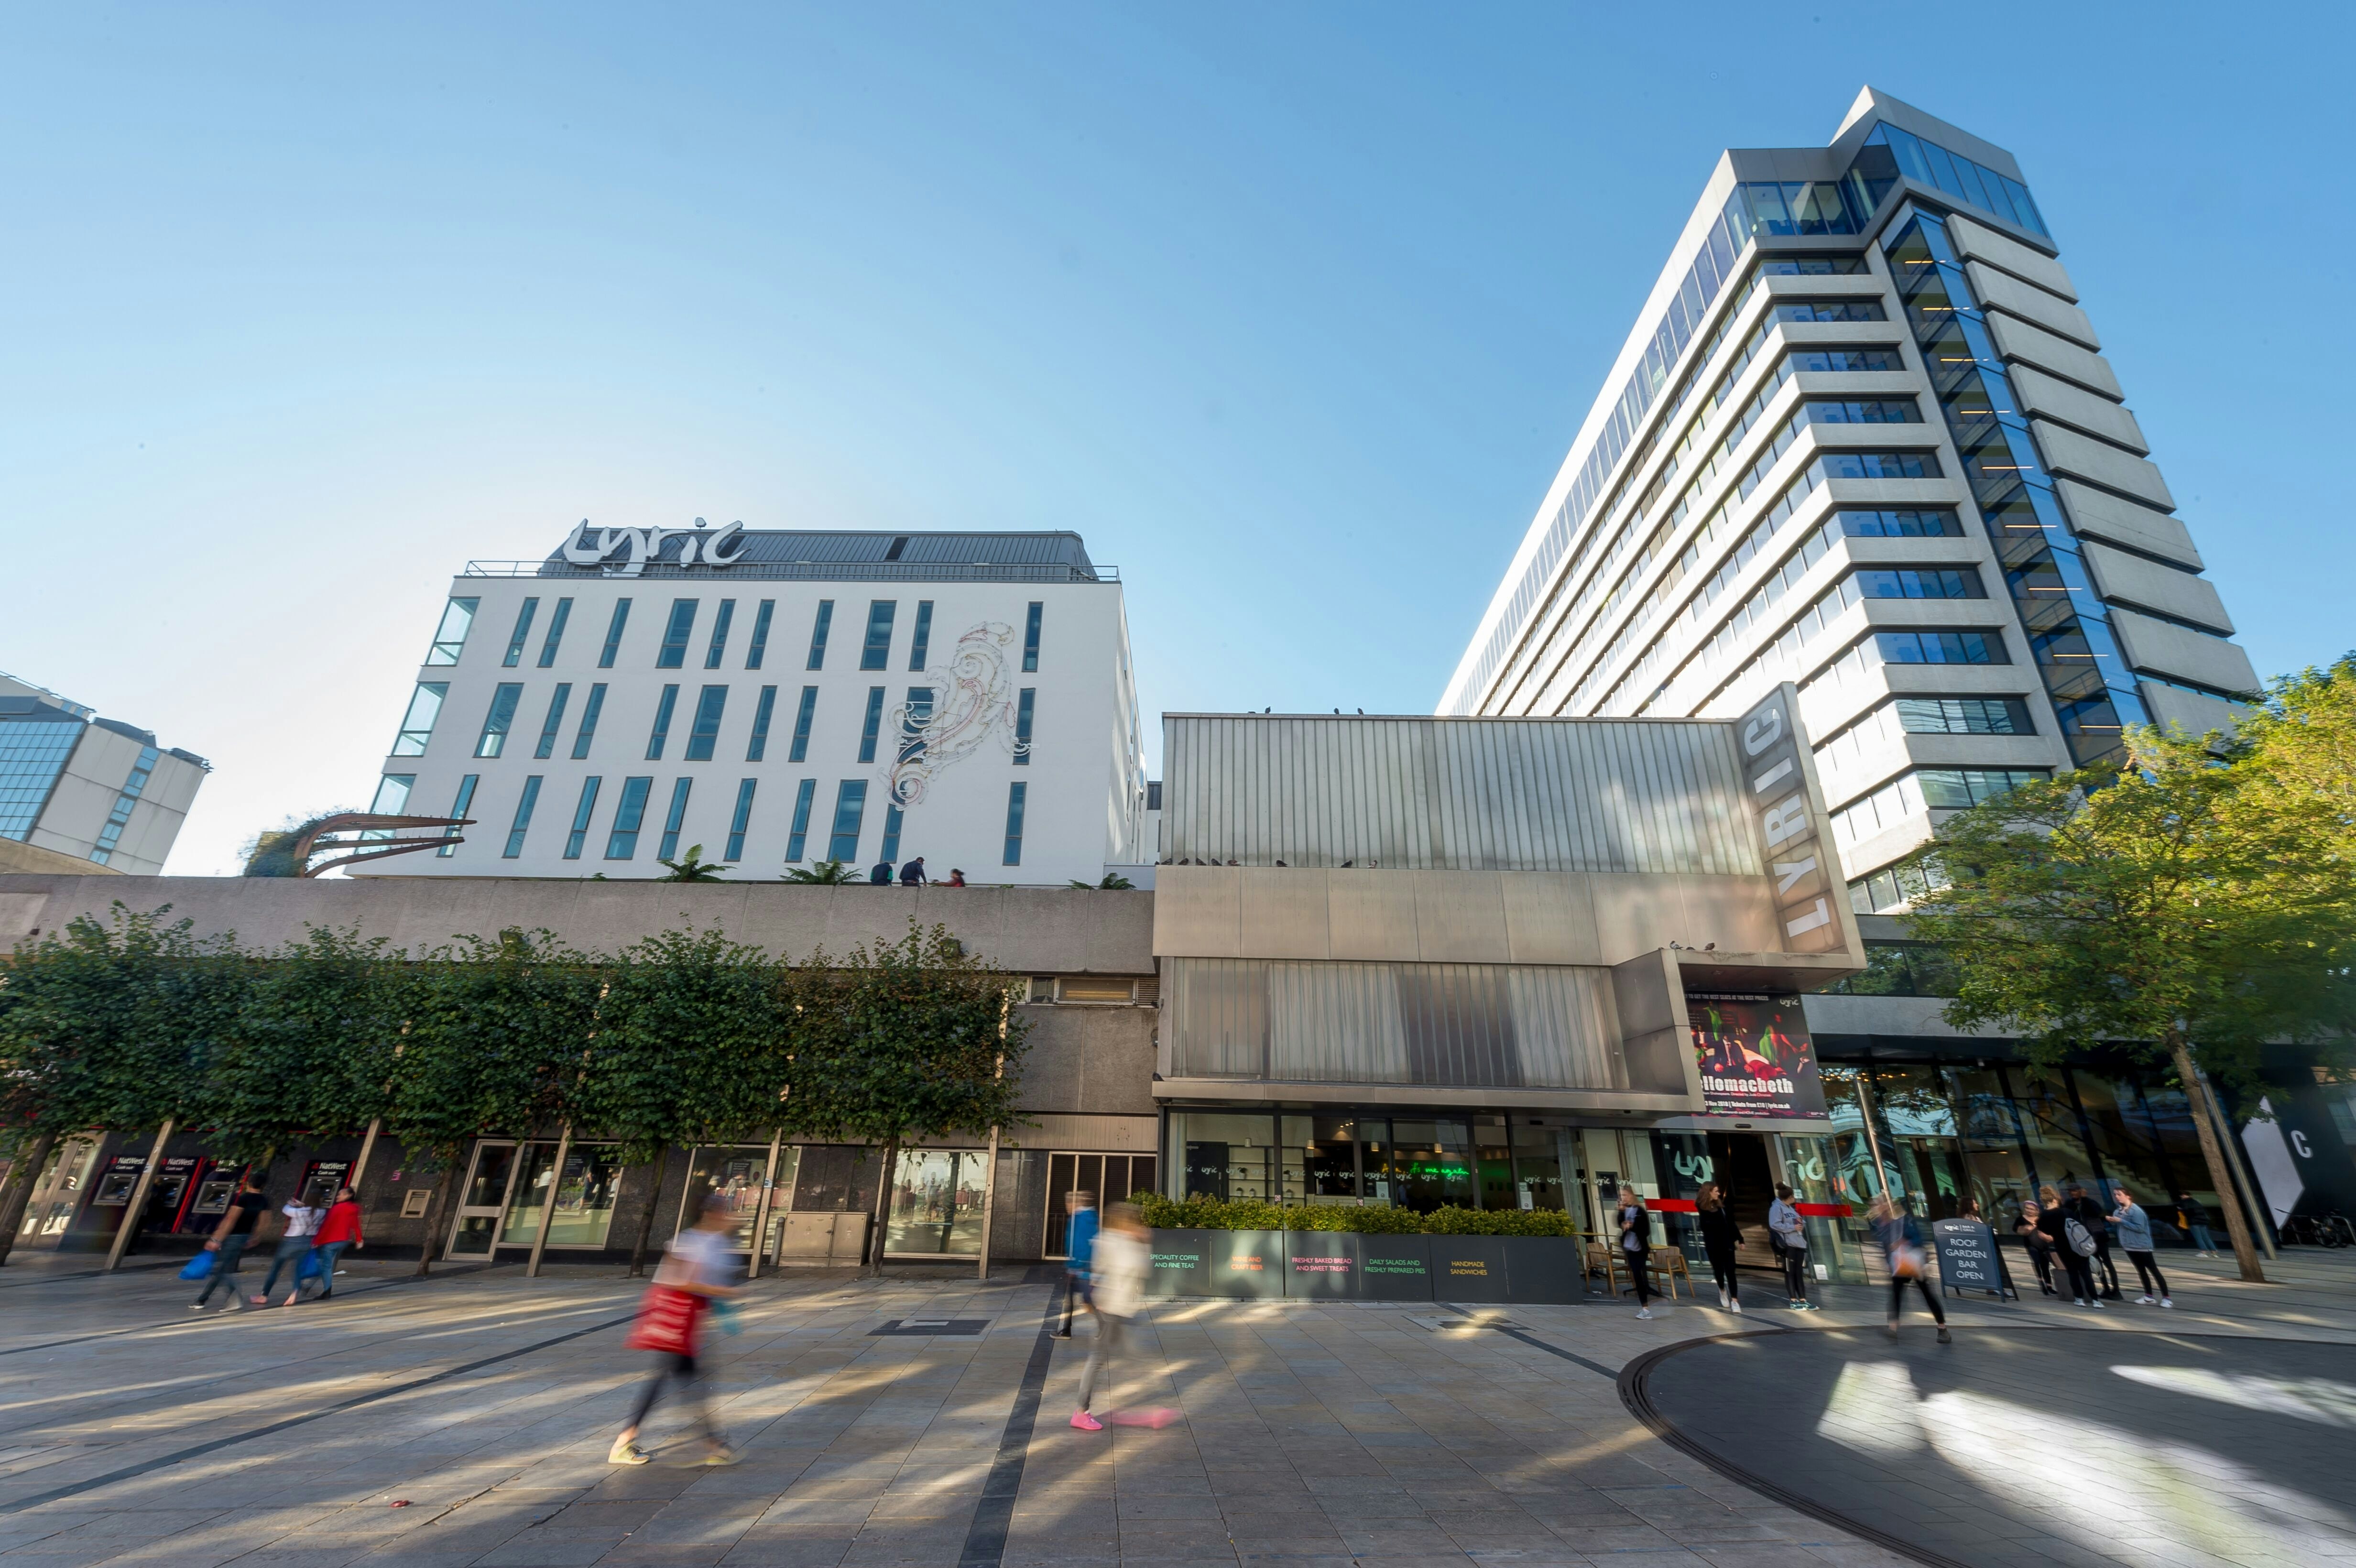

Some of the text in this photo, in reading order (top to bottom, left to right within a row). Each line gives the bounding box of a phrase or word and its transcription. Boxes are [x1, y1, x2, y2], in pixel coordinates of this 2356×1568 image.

[1744, 708, 1830, 938] LYRIC
[2291, 1130, 2313, 1158] C
[1950, 1238, 1979, 1247] ROOF
[1945, 1249, 1987, 1258] GARDEN
[1958, 1260, 1979, 1268] BAR
[1956, 1271, 1985, 1280] OPEN
